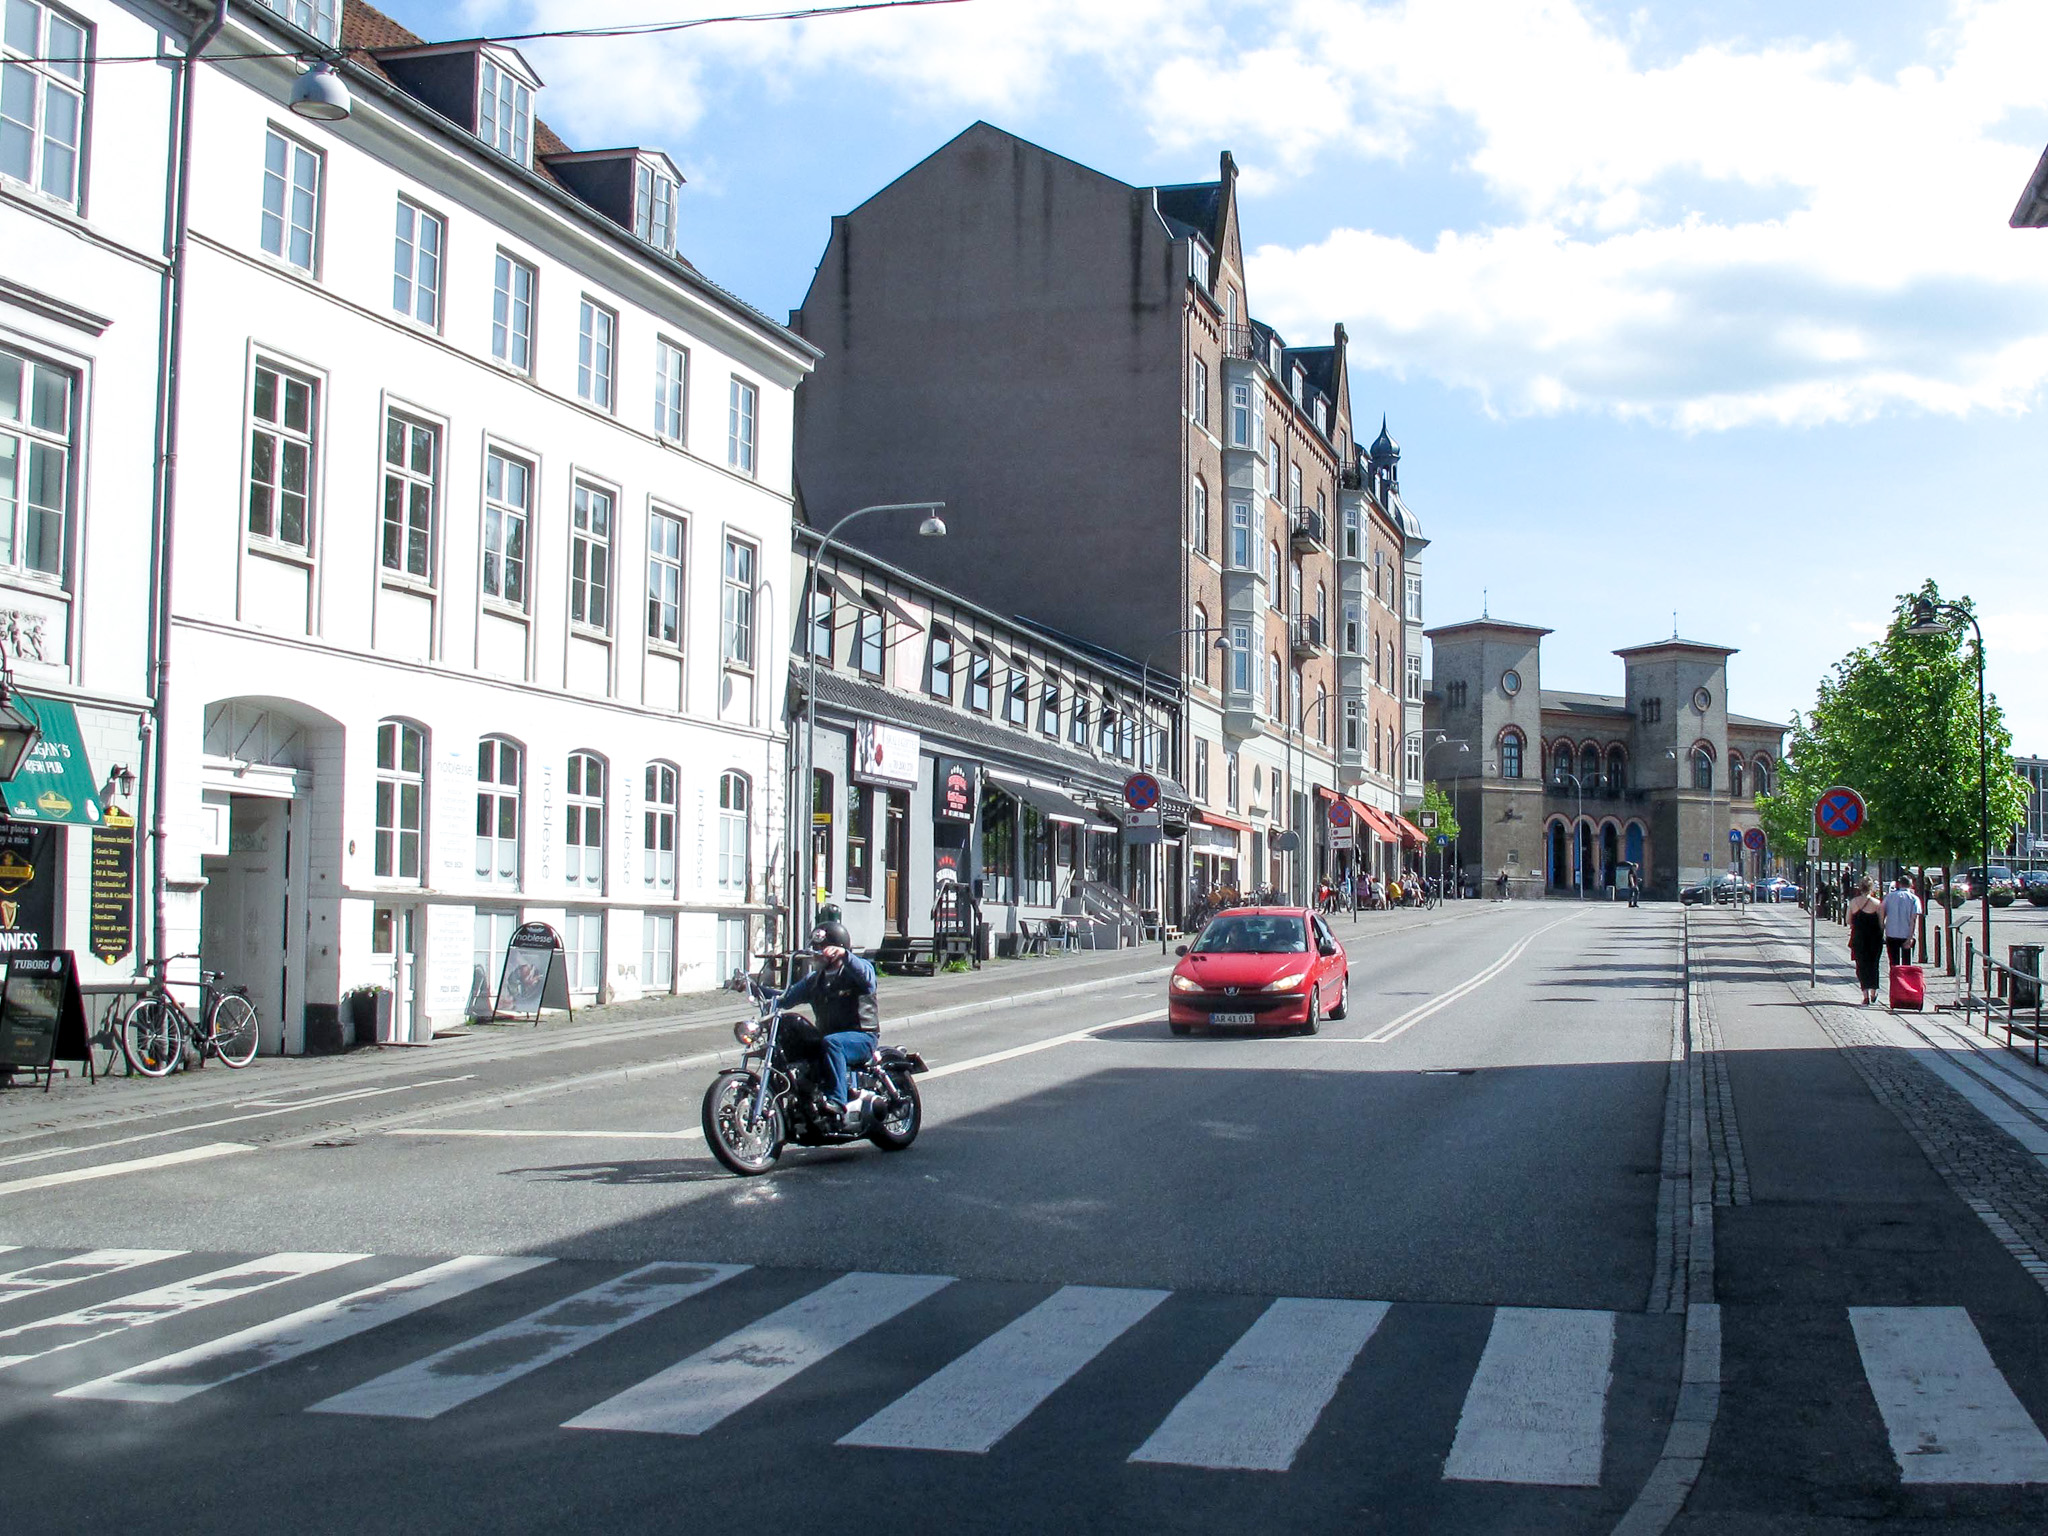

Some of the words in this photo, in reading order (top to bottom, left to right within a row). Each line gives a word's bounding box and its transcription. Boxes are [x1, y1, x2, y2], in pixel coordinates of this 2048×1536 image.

[45, 761, 64, 774] PUB
[437, 761, 473, 777] noblesse
[542, 772, 552, 880] noblesse
[624, 784, 632, 885] noblesse
[696, 795, 704, 888] noblesse
[516, 934, 553, 943] noblesse
[14, 959, 50, 970] TUBORG
